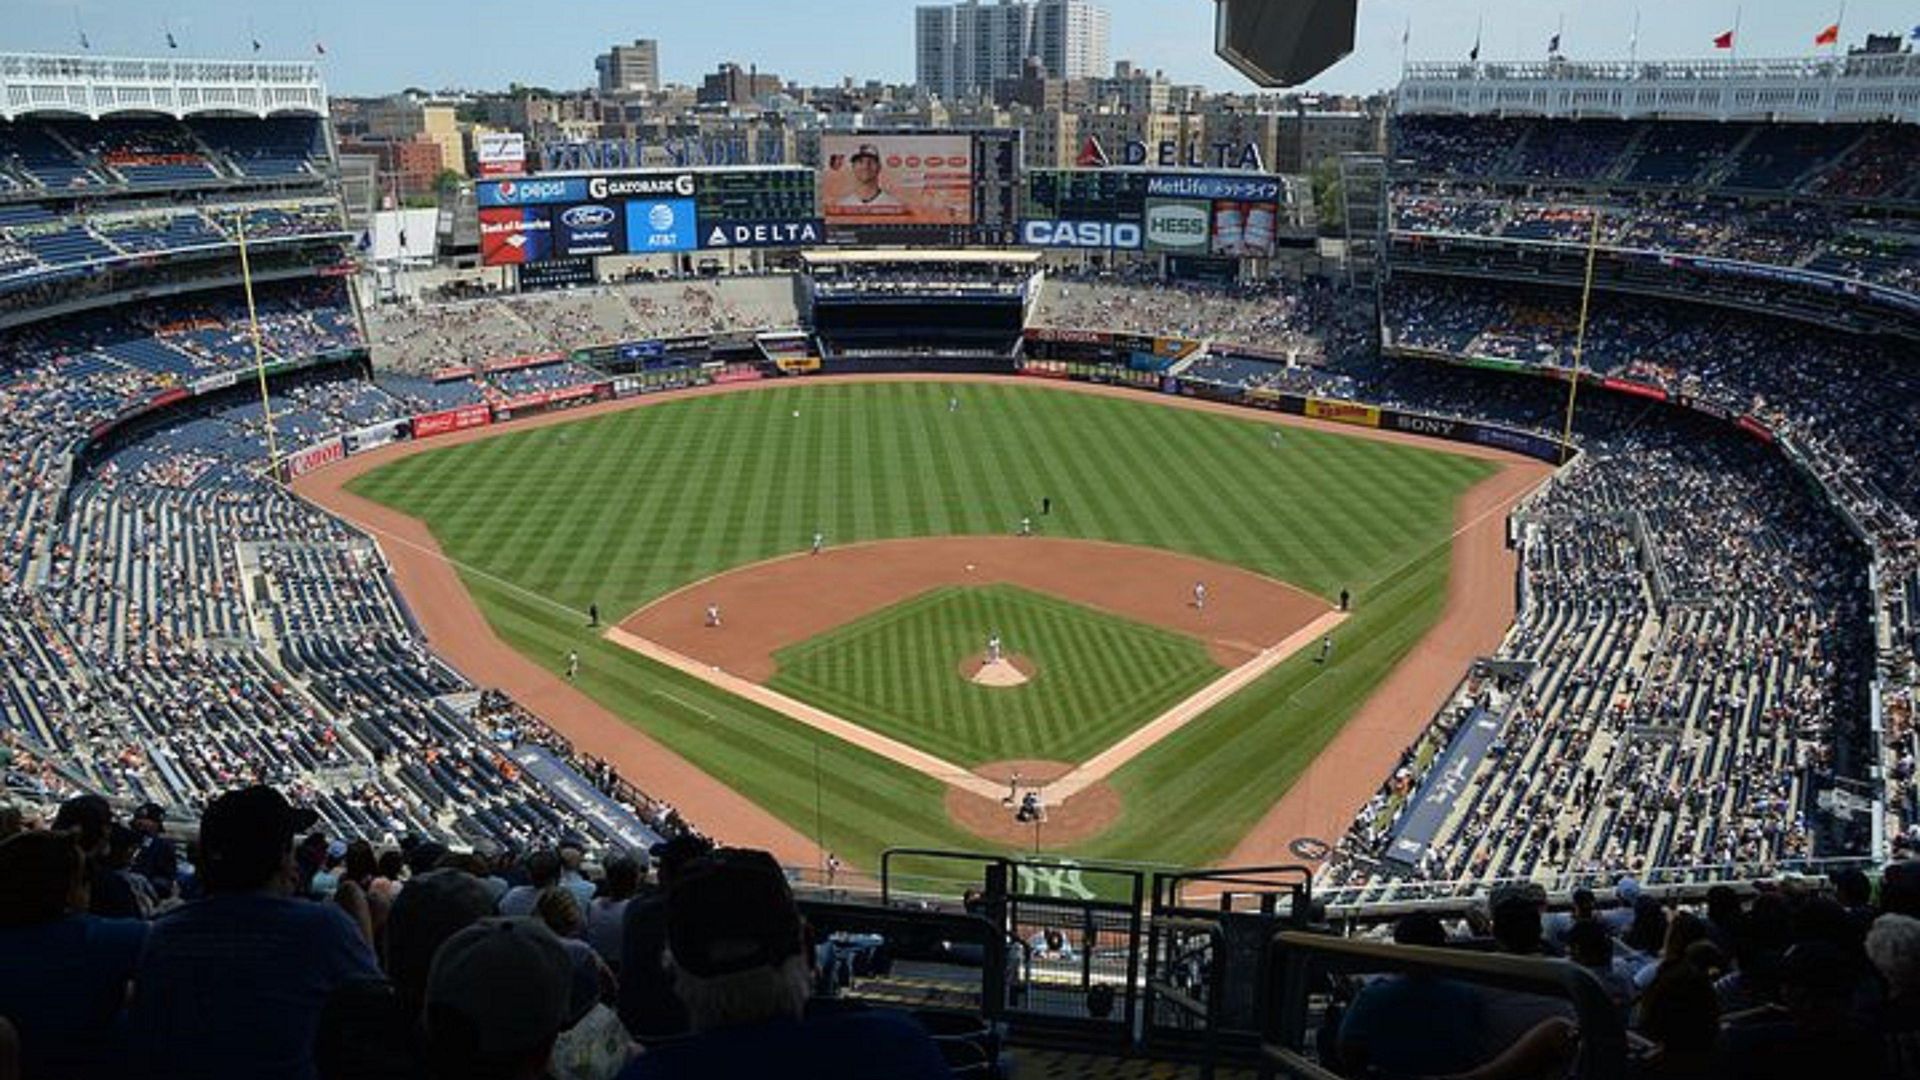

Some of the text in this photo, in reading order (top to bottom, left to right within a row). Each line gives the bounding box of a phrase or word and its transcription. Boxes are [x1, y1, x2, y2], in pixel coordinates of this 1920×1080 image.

[1125, 140, 1262, 171] DELTA
[520, 181, 565, 200] pepsi
[590, 178, 607, 199] G
[609, 180, 674, 196] GATORADE
[675, 175, 694, 196] G
[1147, 178, 1208, 195] MetLife
[735, 223, 816, 242] DELTA
[1025, 221, 1140, 247] CASIO
[1151, 217, 1205, 235] HESS
[648, 234, 676, 246] AT&T
[1398, 416, 1454, 435] SONY
[290, 441, 342, 477] Canon
